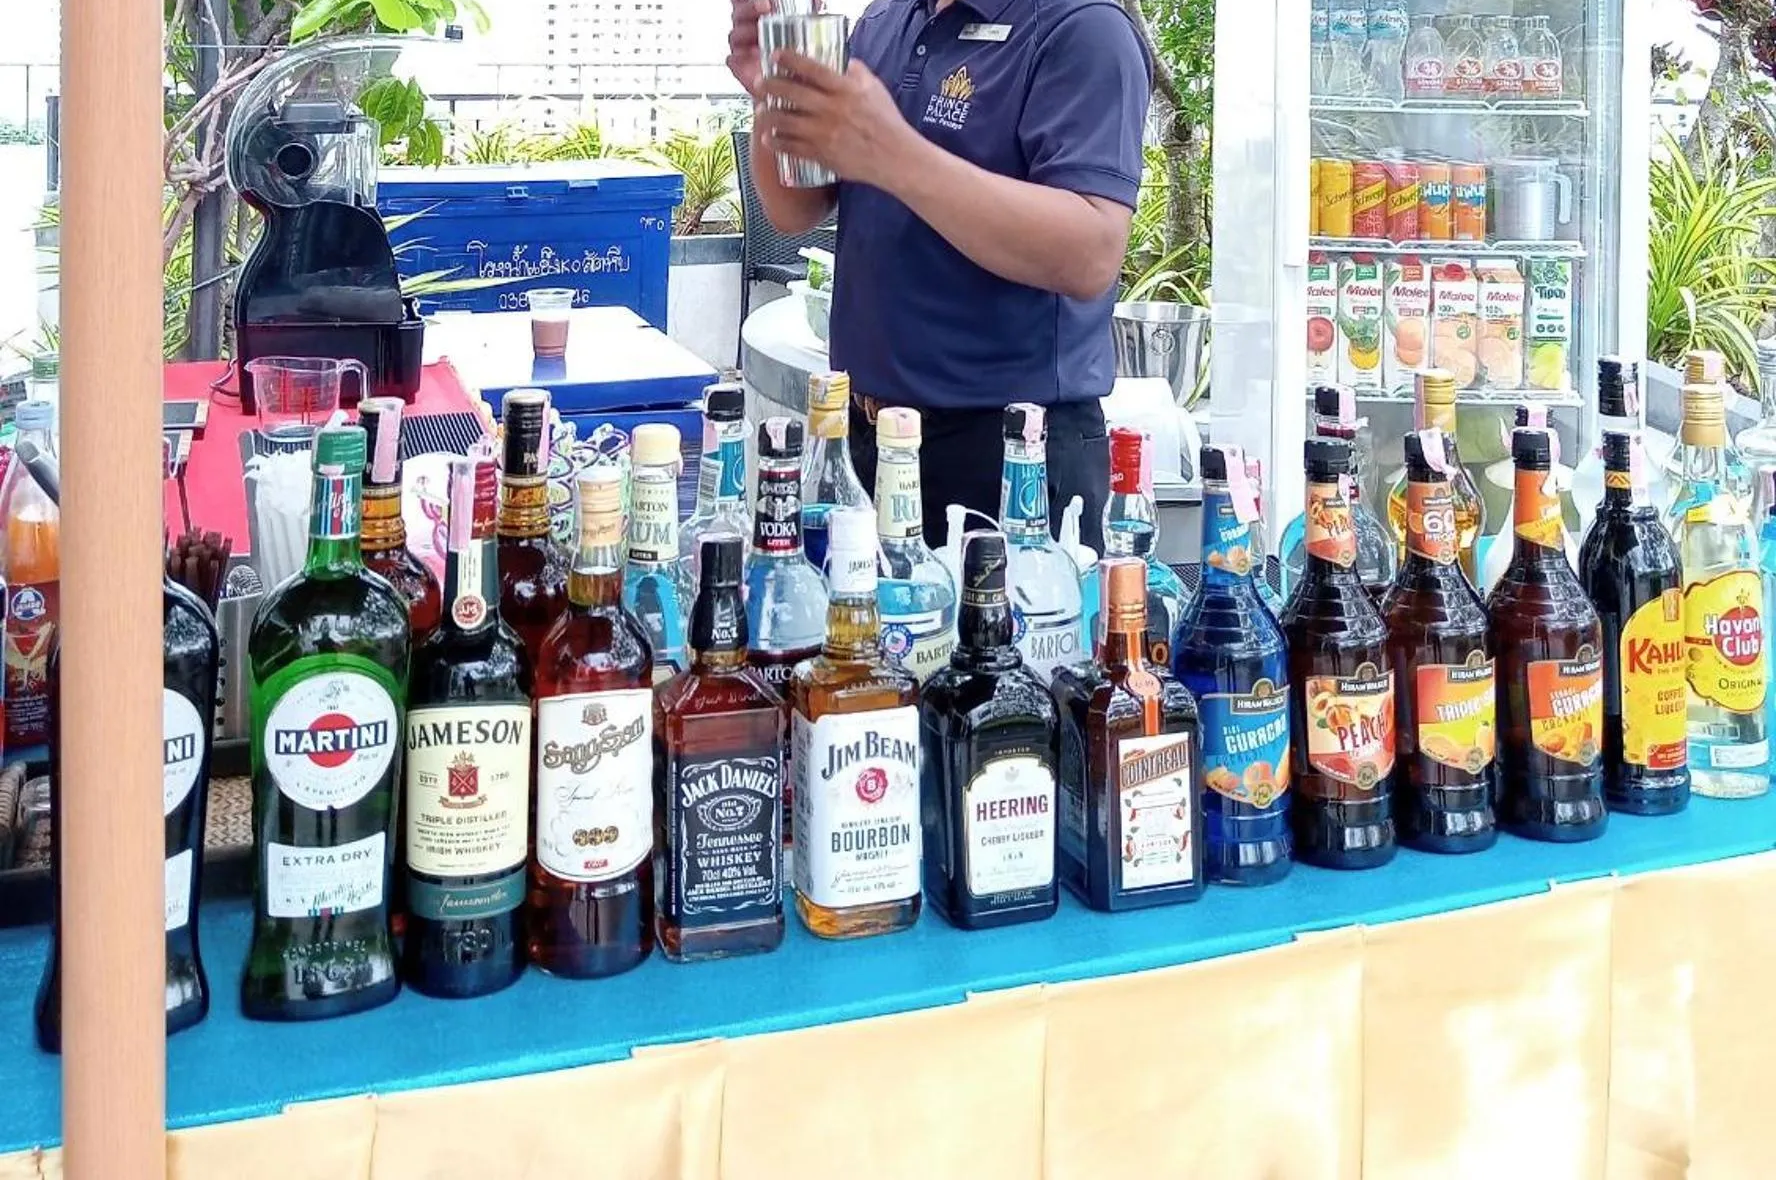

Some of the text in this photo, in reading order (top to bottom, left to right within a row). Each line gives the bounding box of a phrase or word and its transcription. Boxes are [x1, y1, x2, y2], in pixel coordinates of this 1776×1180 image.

[926, 104, 968, 124] PALACE
[930, 95, 970, 112] PRINCE
[759, 521, 797, 537] VODKA
[1722, 637, 1760, 657] Club
[278, 722, 386, 754] MARTINI
[408, 719, 524, 751] JAMESON
[1337, 712, 1387, 751] PEACH
[821, 730, 917, 781] JIM BEAM
[1121, 742, 1187, 788] COINTREAU
[681, 770, 720, 808] JACK
[421, 813, 453, 825] TRIPLE
[976, 794, 1049, 823] HEERING
[696, 832, 764, 850] Tennessee
[831, 823, 911, 854] BOURBON
[282, 847, 372, 867] EXTRA DRY
[697, 850, 762, 869] WHISKEY
